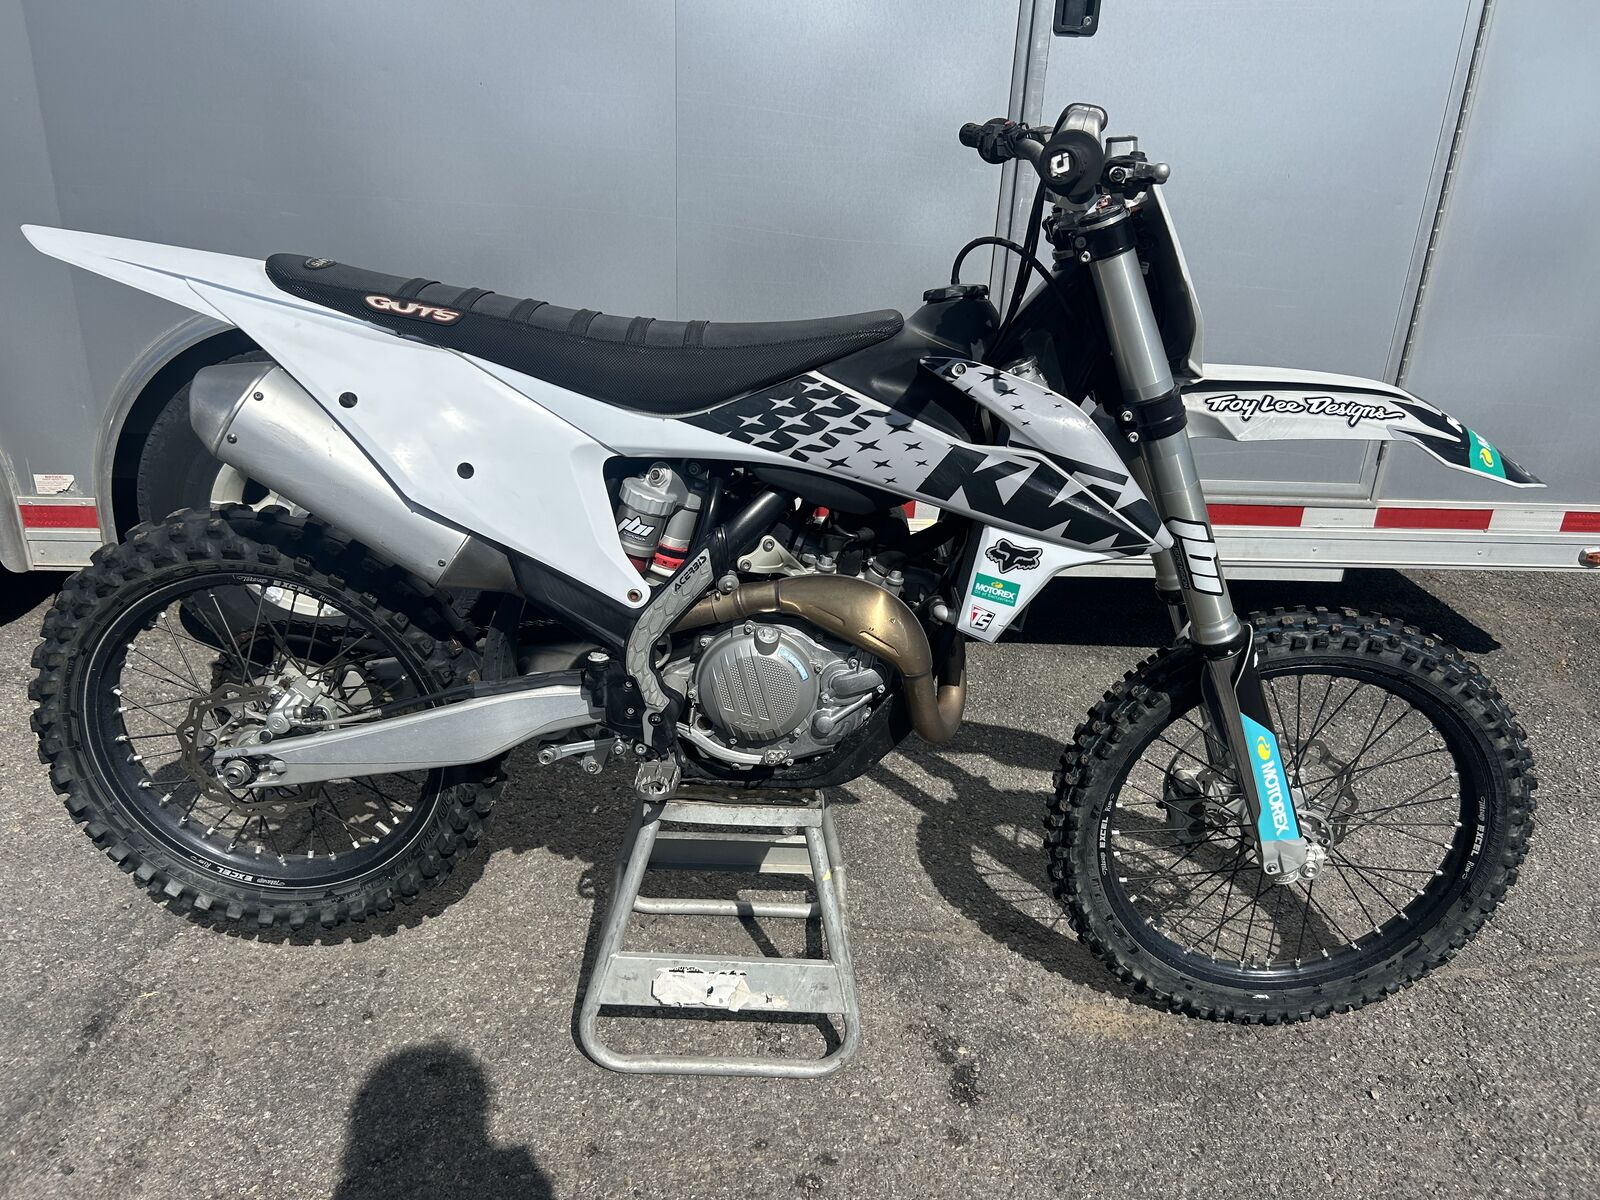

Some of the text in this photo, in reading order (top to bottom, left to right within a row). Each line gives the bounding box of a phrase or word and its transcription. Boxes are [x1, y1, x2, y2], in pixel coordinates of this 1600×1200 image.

[364, 294, 461, 322] GUTS
[1205, 394, 1405, 428] Troy Lee Designs
[674, 556, 707, 592] ACERBIS
[975, 582, 1016, 600] MOTOREX
[1261, 760, 1289, 836] MOTOREX
[1099, 816, 1109, 849] EXCEL
[1470, 824, 1485, 857] EXCEL
[216, 866, 254, 882] EXCEL
